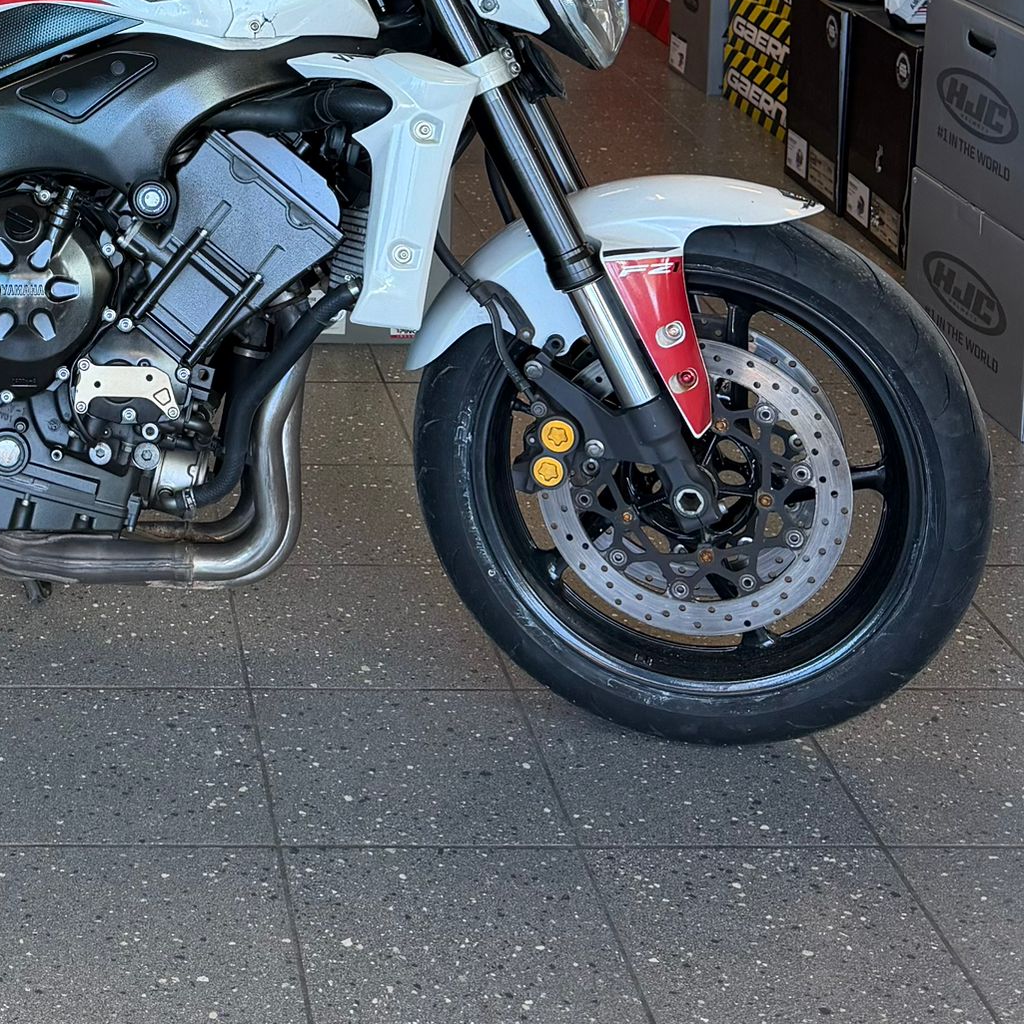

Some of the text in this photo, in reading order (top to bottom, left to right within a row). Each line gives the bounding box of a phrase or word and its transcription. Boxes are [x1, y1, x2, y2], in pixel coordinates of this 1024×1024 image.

[945, 76, 1009, 135] HJC
[937, 125, 1011, 182] #1 IN THE WORLD
[0, 283, 45, 296] YAMAHA
[932, 259, 997, 326] HJC
[946, 321, 964, 346] THE
[964, 335, 1000, 375] WORLD
